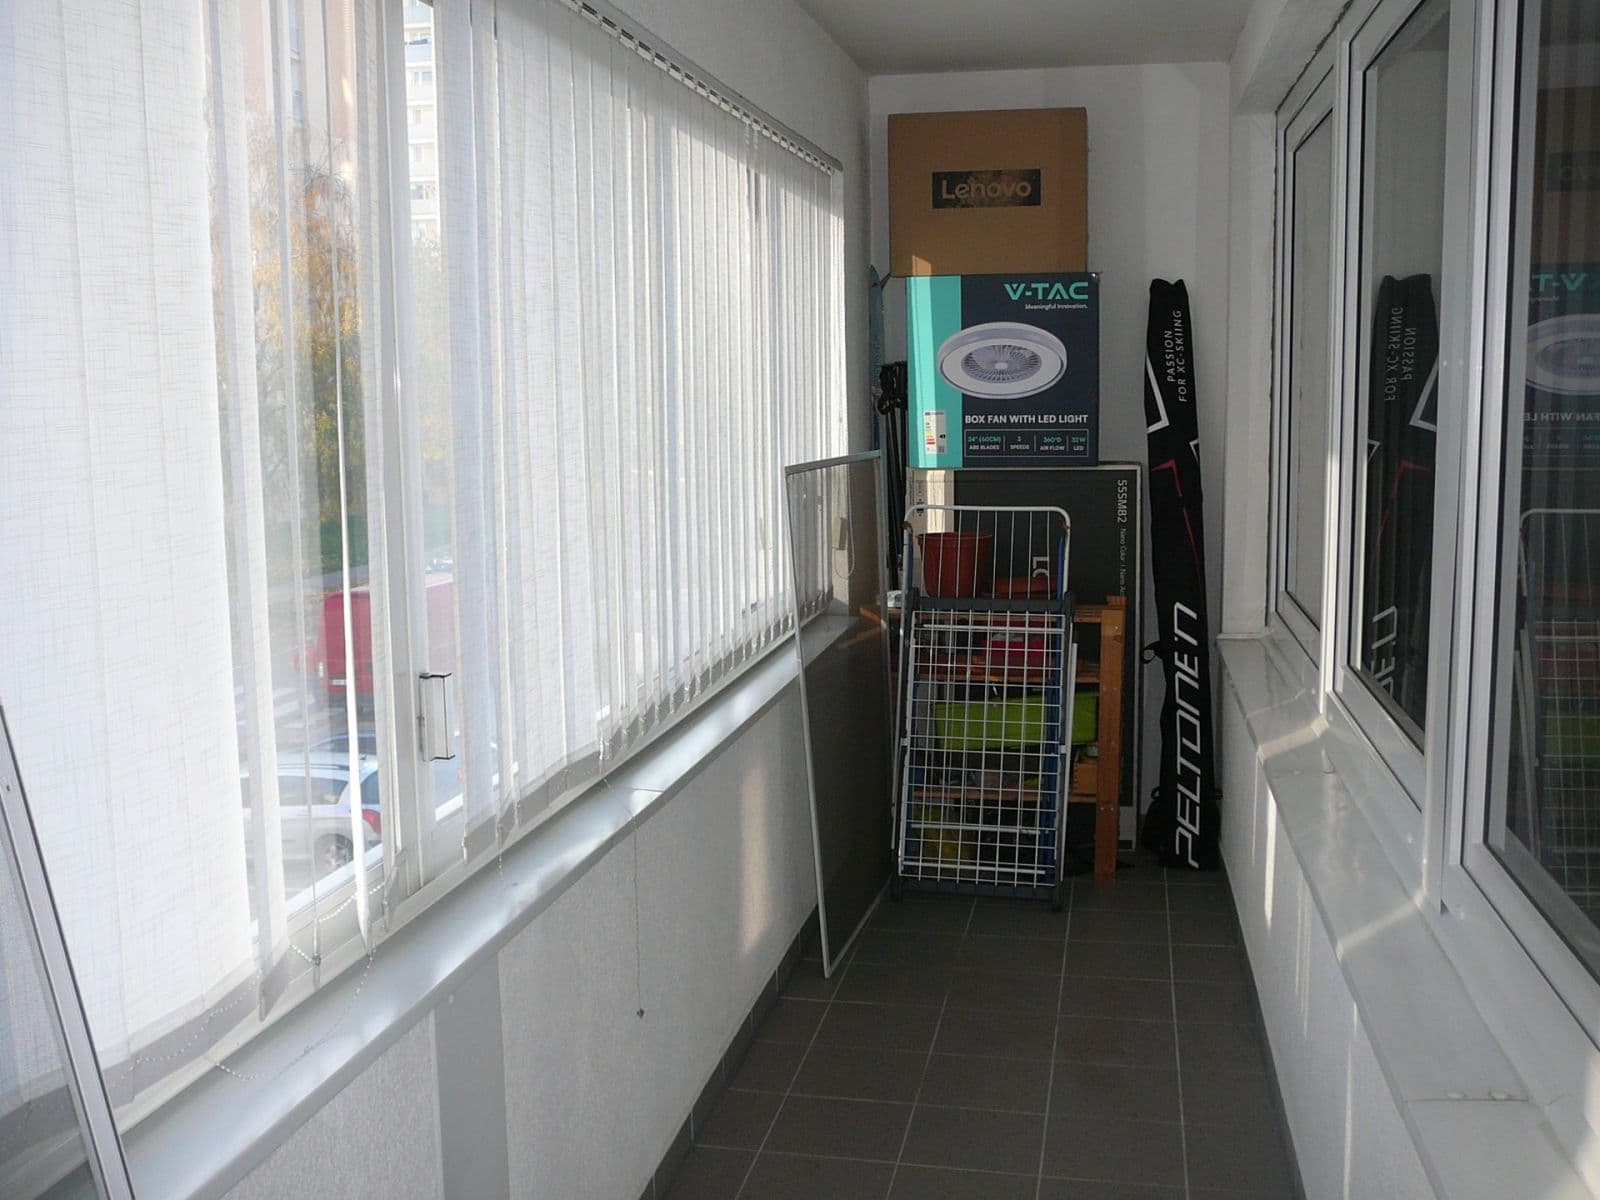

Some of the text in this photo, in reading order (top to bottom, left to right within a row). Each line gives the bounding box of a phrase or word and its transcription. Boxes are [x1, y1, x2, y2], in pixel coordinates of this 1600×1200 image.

[942, 178, 1032, 199] Lenovo
[1003, 281, 1089, 300] V-TAC
[1164, 330, 1176, 382] PASSION
[1173, 310, 1188, 402] FOR XC-SKIING
[965, 414, 1088, 424] BOX FAN WITH LED LIGHT
[1174, 602, 1202, 869] PELTONEN
